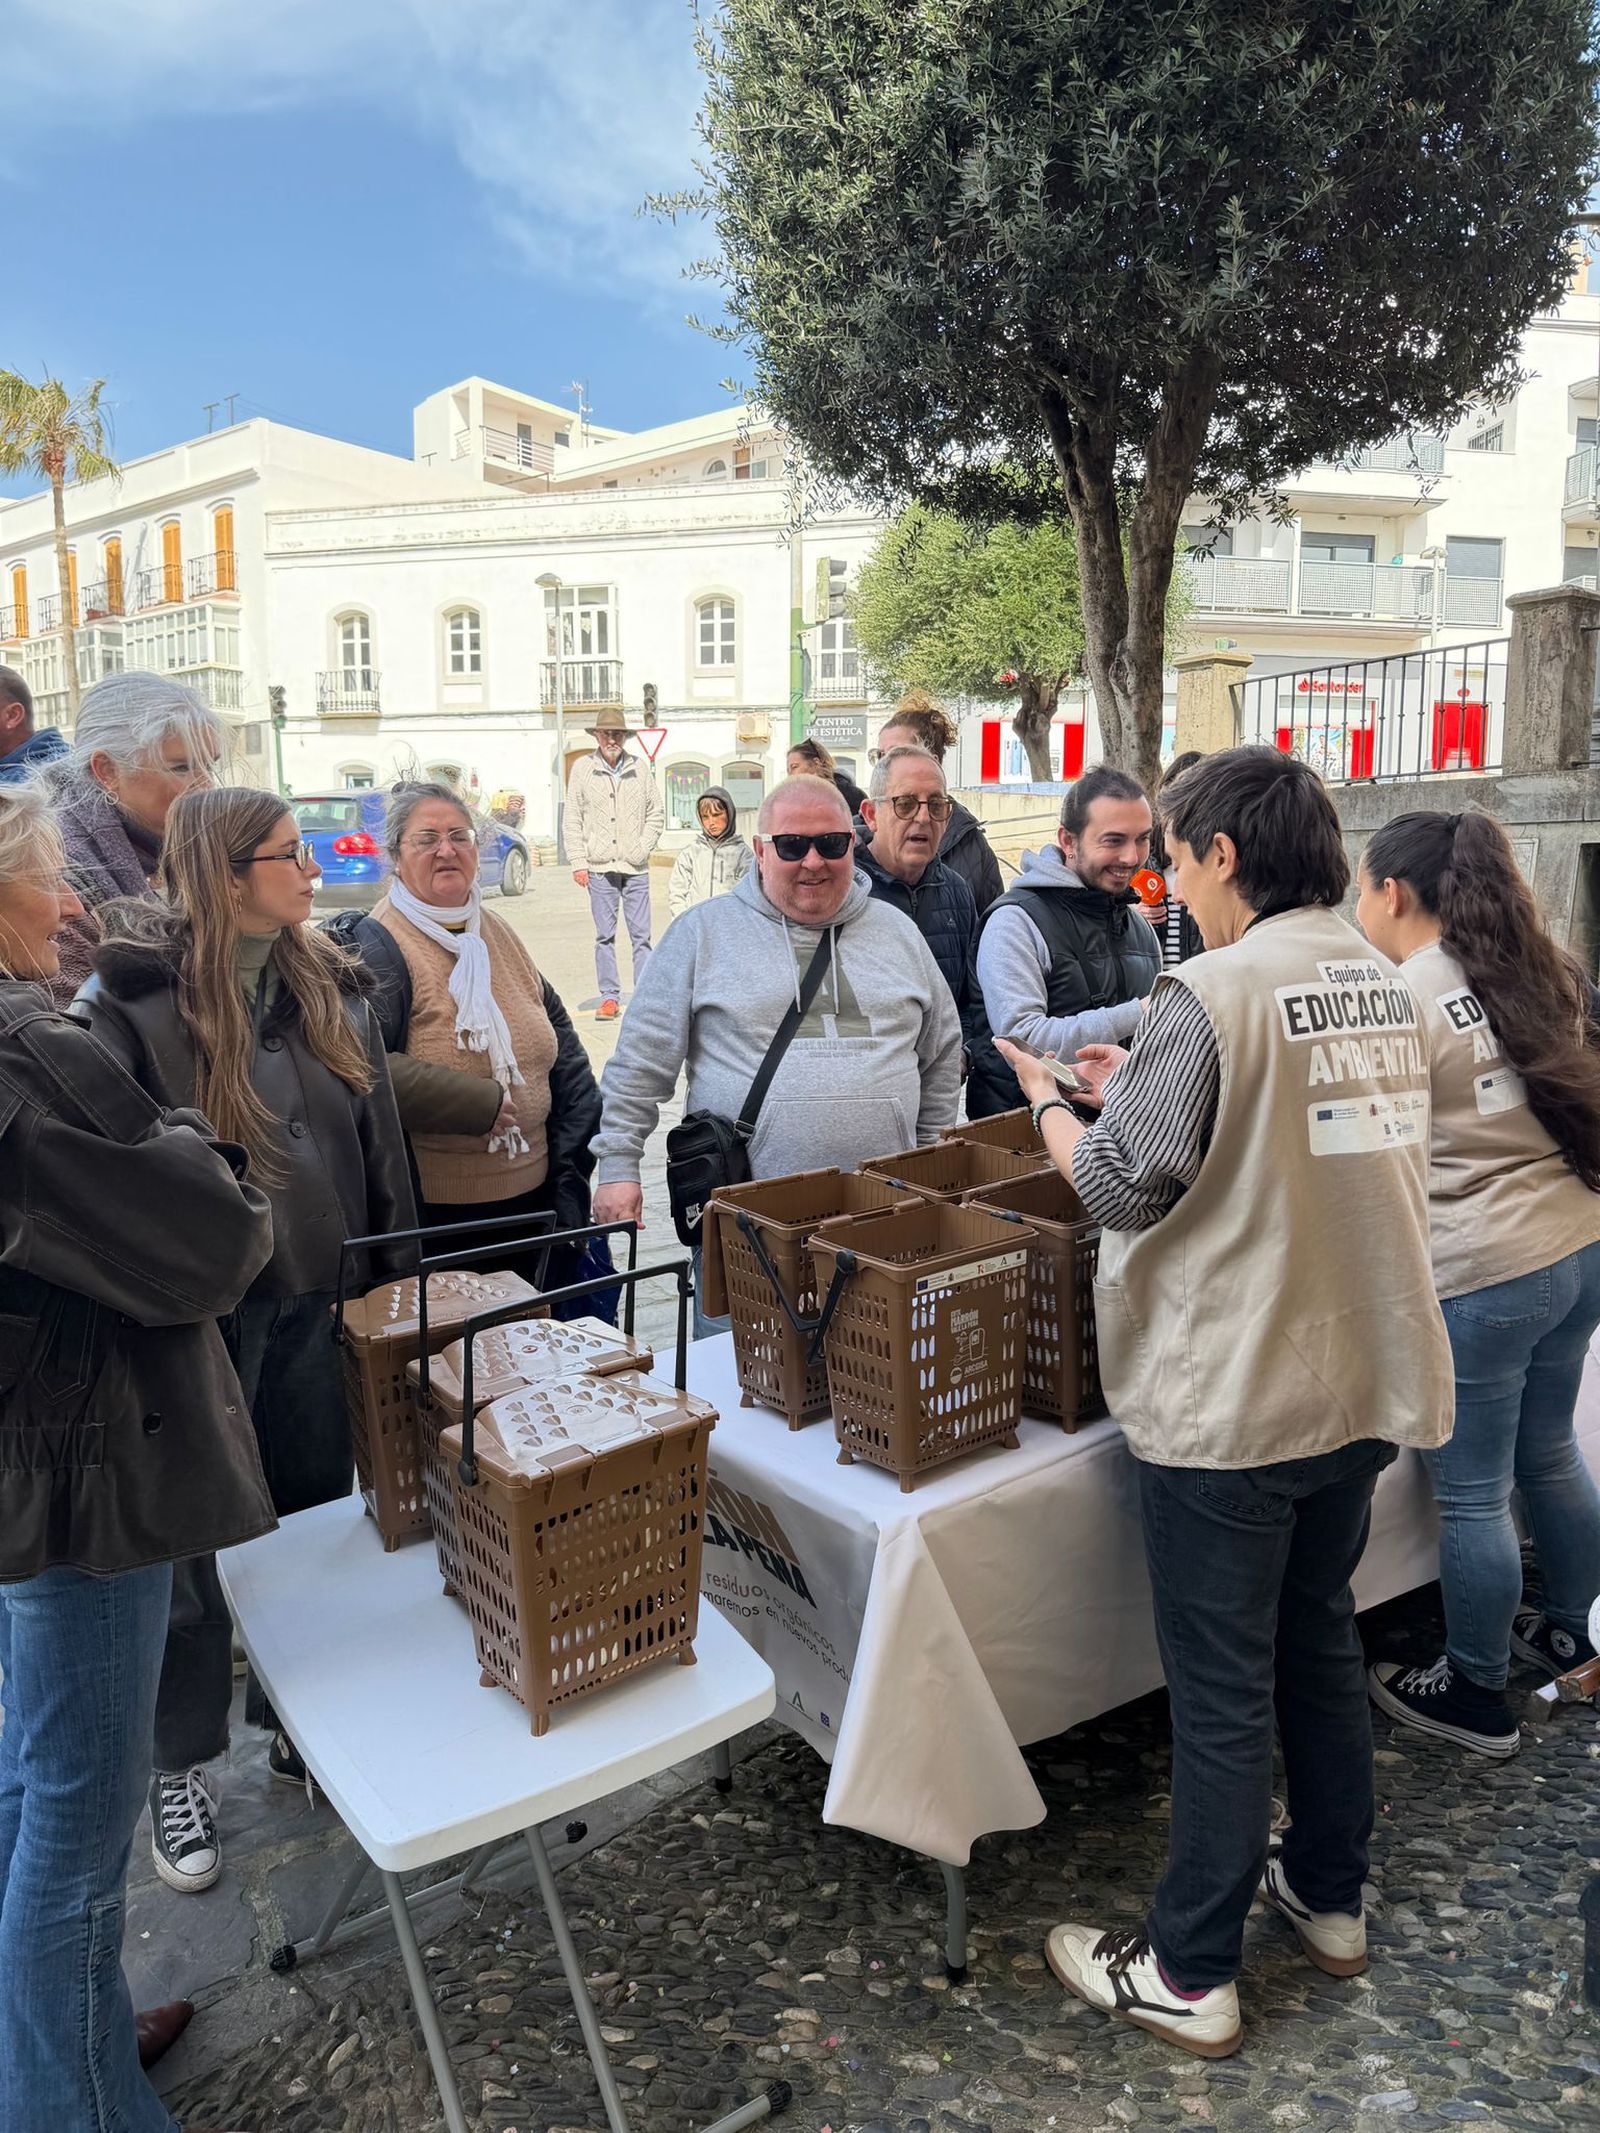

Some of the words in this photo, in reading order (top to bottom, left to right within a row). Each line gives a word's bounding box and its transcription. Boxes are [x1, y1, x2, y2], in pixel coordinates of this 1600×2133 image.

[806, 728, 818, 737] DE
[820, 726, 863, 737] ESTÉTICA
[815, 718, 853, 727] CENTRO
[1325, 965, 1366, 987] Equipo
[1368, 964, 1381, 981] de
[1283, 980, 1416, 1036] EDUCACIÓN
[1444, 995, 1483, 1030] ED
[1308, 1037, 1427, 1087] AMBIENTAL
[700, 1589, 760, 1618] maremos
[765, 1605, 780, 1623] en
[782, 1618, 819, 1655] nuevos
[706, 1572, 770, 1601] residuos
[773, 1596, 836, 1656] orgánicos
